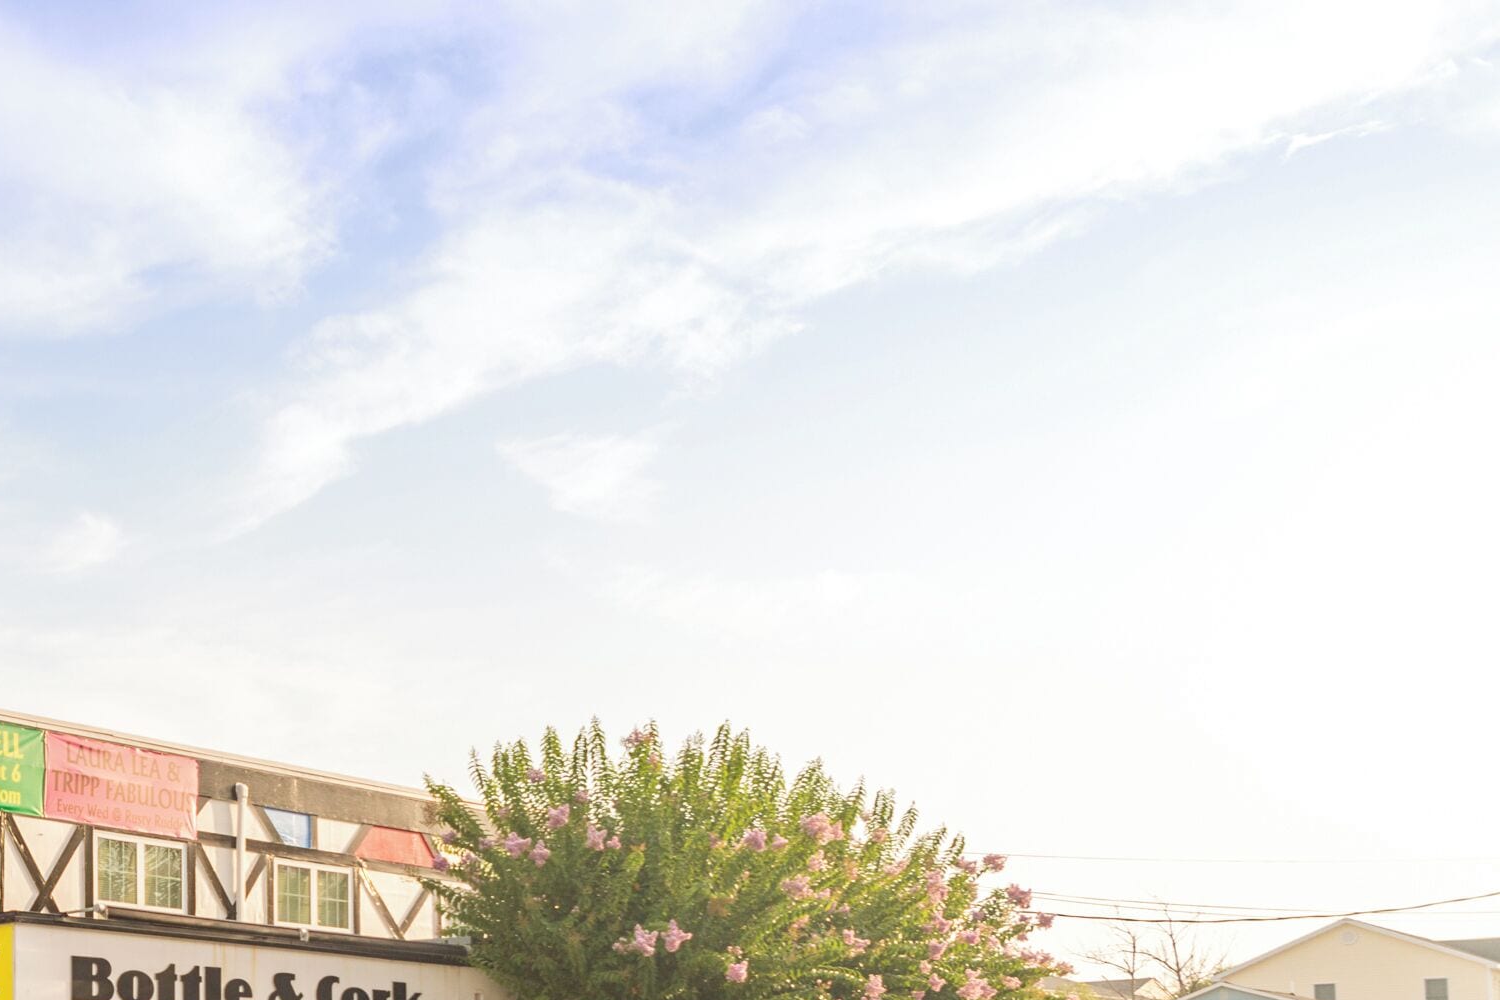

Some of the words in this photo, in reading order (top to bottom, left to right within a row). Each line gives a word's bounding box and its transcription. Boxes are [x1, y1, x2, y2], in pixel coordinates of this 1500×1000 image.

[11, 764, 22, 783] 6
[66, 743, 125, 774] LAURA
[131, 754, 161, 780] LEA
[167, 761, 181, 783] &
[52, 770, 100, 797] TRIPP
[106, 778, 196, 813] FABULOUS
[57, 799, 83, 817] Every
[87, 803, 108, 820] Wed
[114, 808, 122, 822] @
